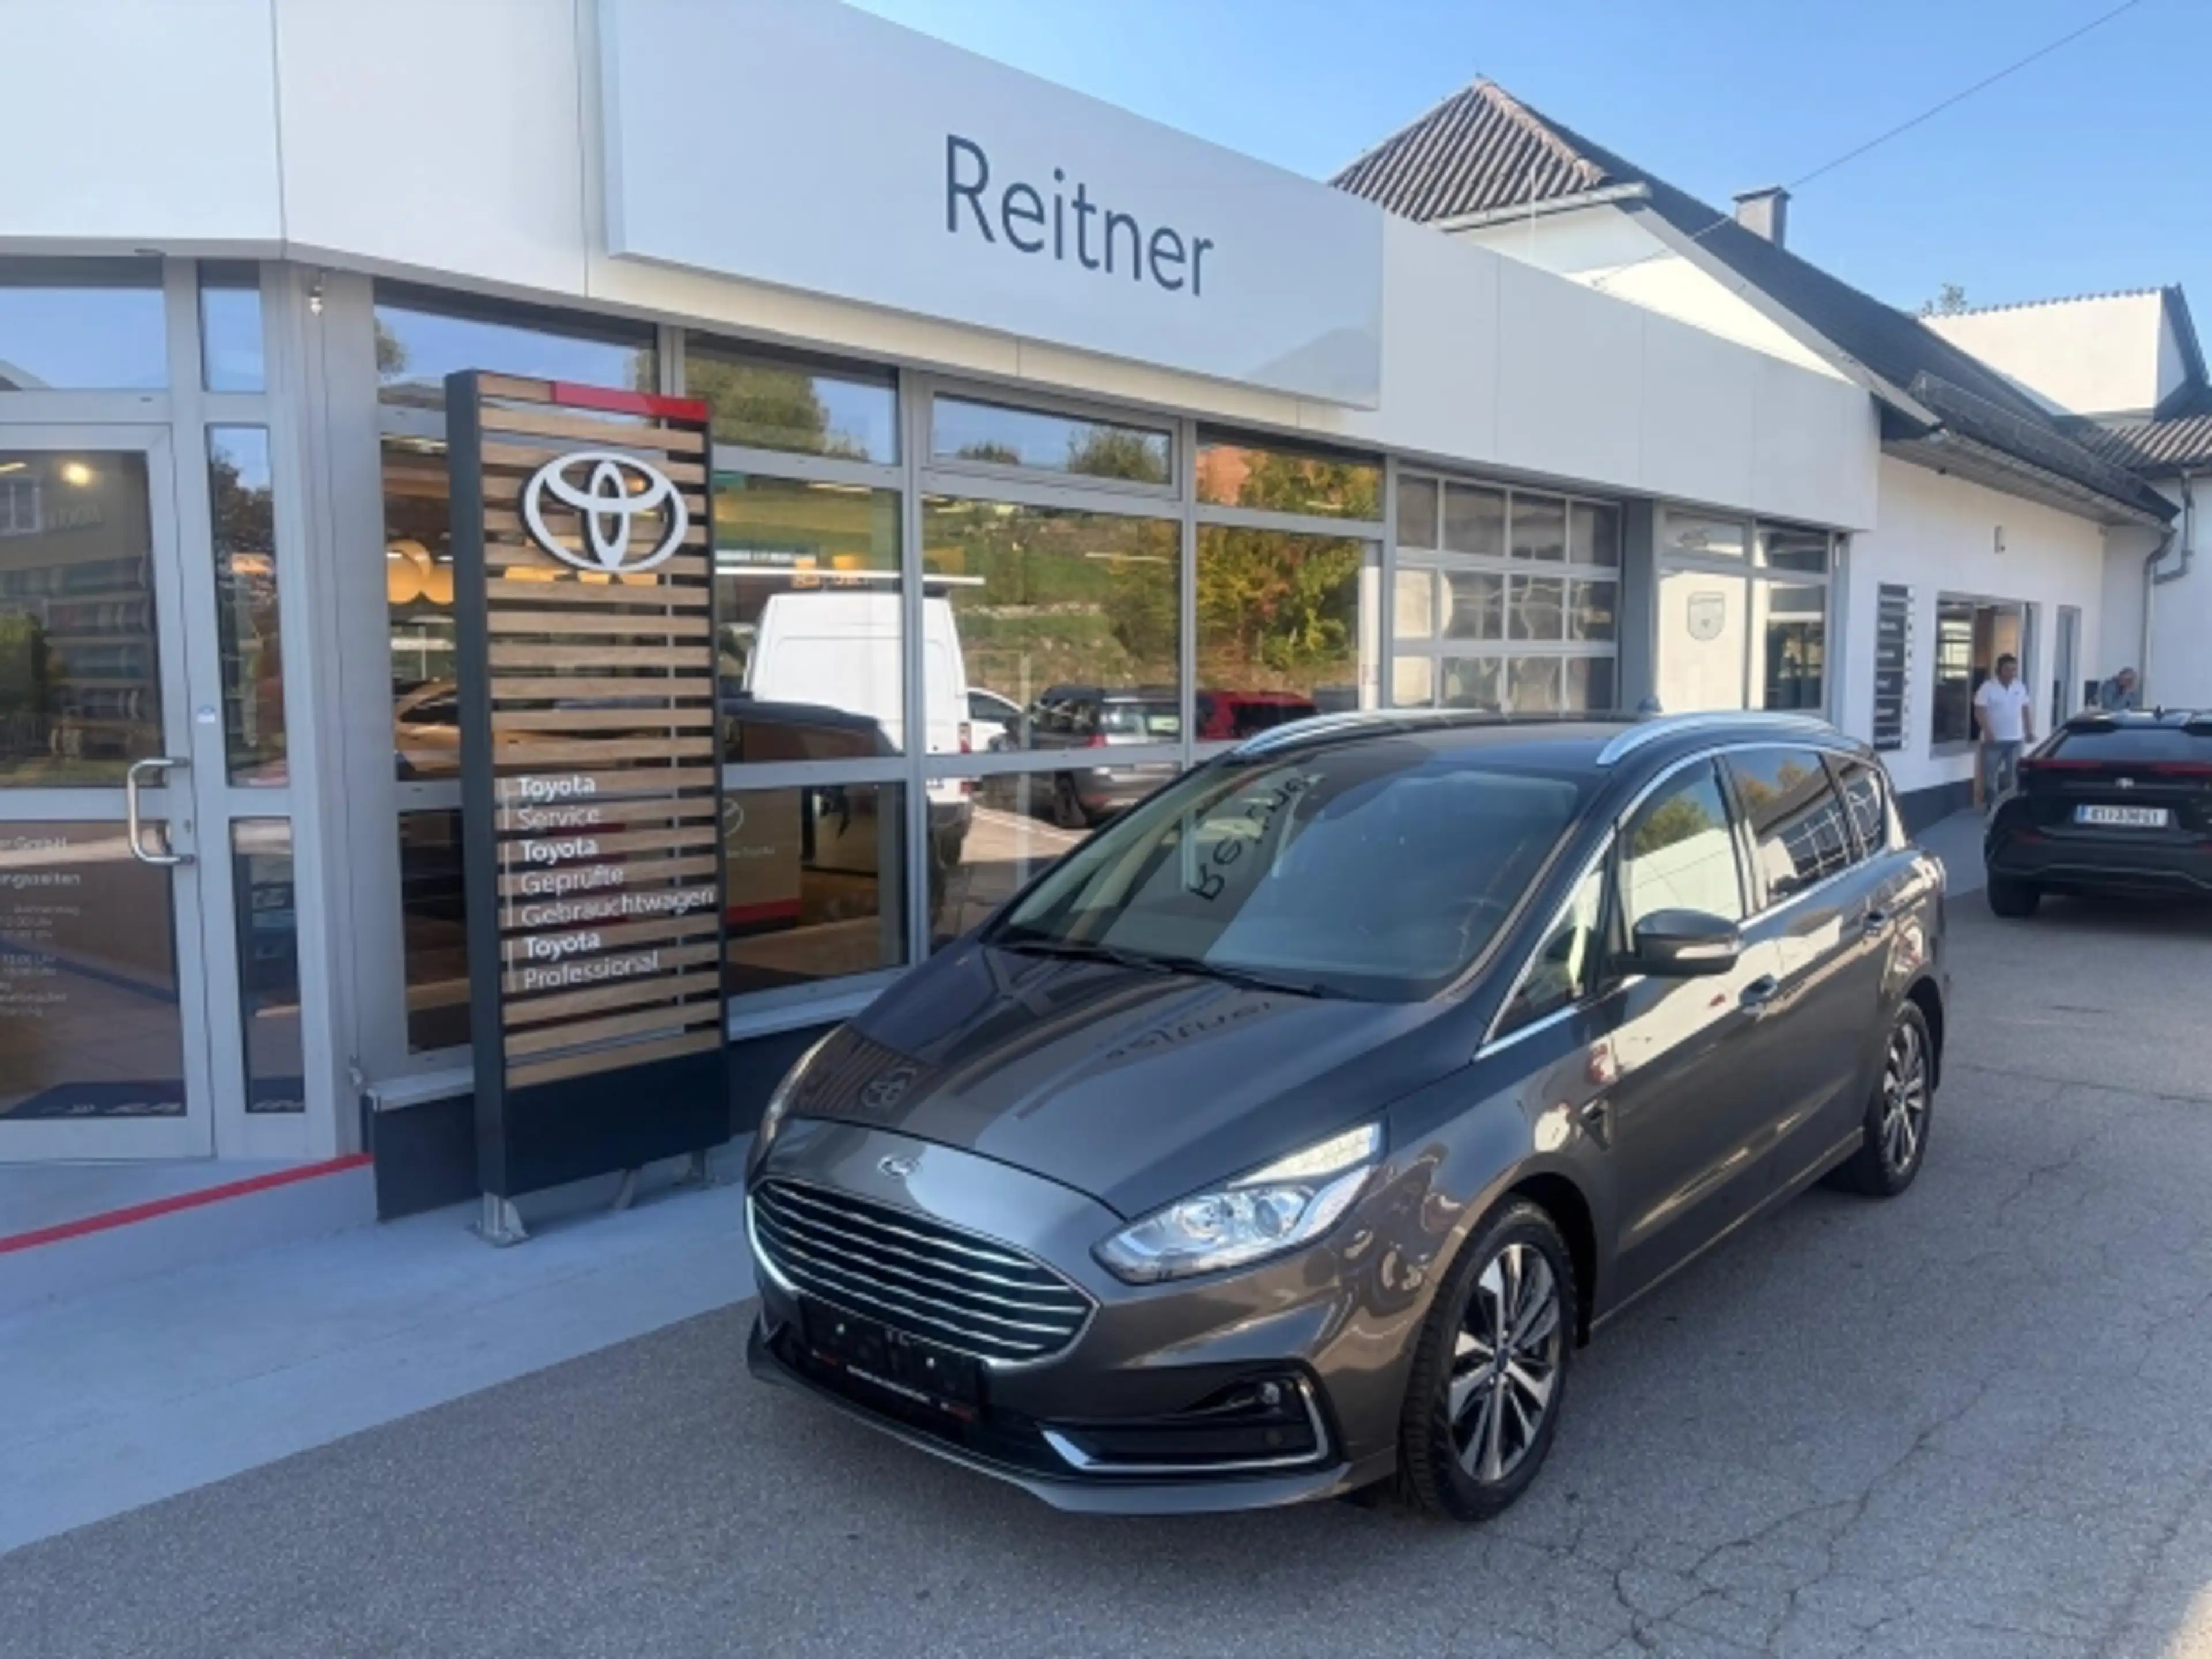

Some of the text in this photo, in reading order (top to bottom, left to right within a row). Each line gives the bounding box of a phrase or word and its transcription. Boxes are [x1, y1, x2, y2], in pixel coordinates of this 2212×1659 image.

[947, 134, 1214, 297] Reitner
[518, 776, 596, 801] Toyota
[519, 806, 601, 830] Service
[520, 839, 598, 863] Toyota
[522, 888, 714, 926] Gebrauchtwagen
[525, 933, 600, 959] Toyota
[525, 952, 659, 989] Professional
